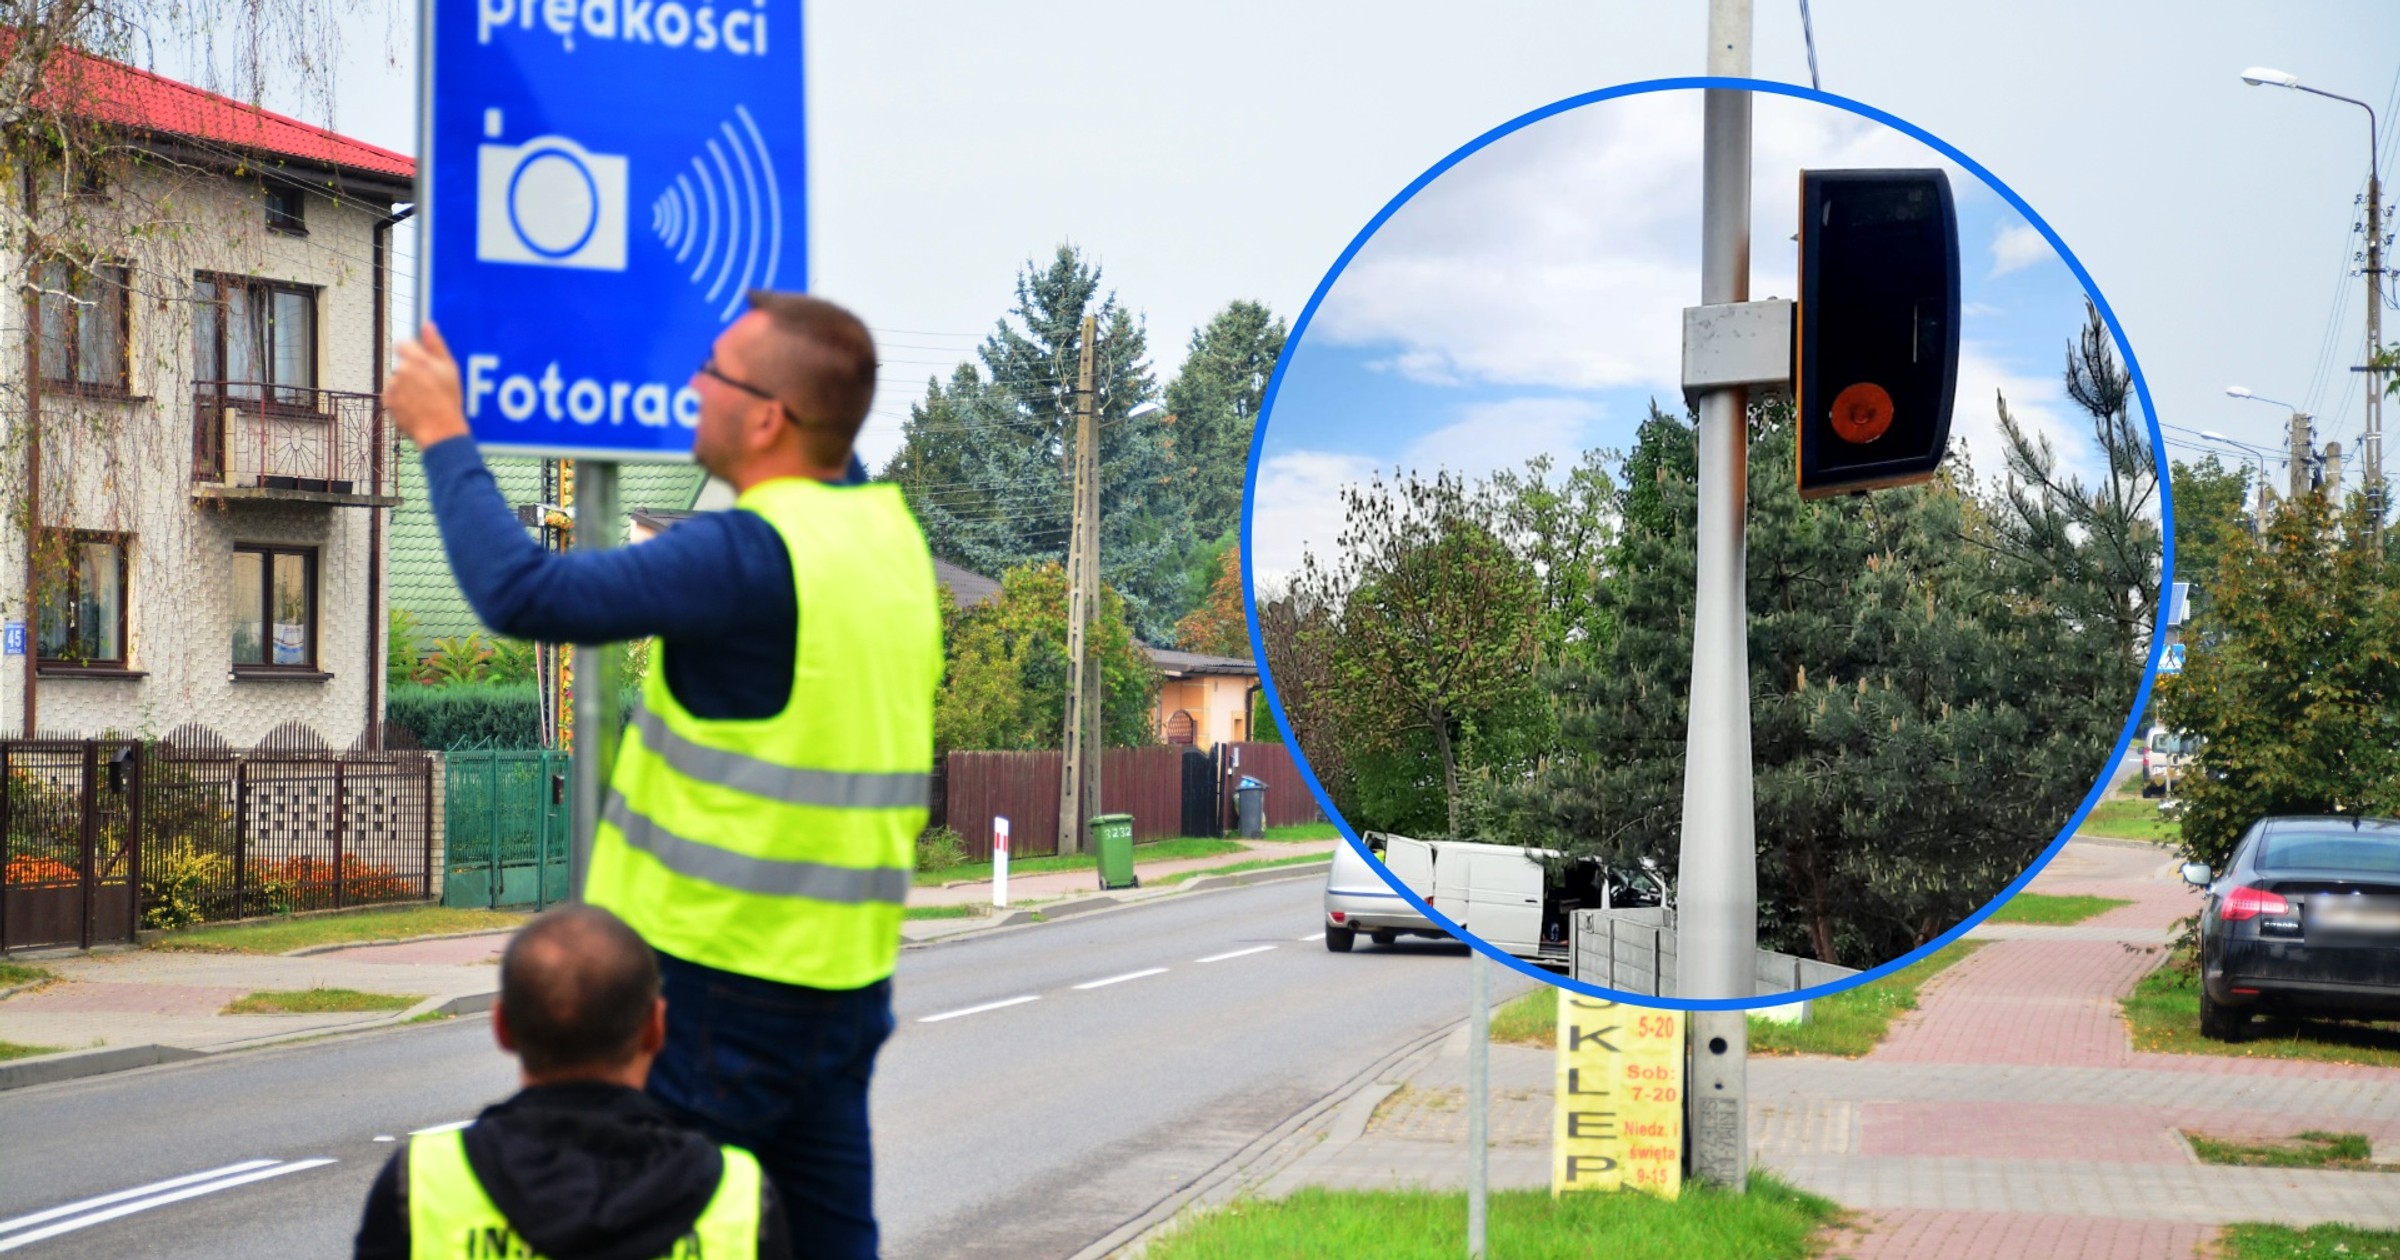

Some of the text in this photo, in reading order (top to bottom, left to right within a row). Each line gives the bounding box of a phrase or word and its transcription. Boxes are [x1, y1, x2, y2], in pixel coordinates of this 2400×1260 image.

[7, 629, 22, 648] 45
[1638, 1015, 1675, 1038] 5-20
[1626, 1064, 1675, 1080] Sob:
[1631, 1087, 1678, 1102] 7-20
[1624, 1121, 1669, 1137] Niedz.
[1629, 1144, 1676, 1164] święta
[1636, 1167, 1668, 1184] 9-15
